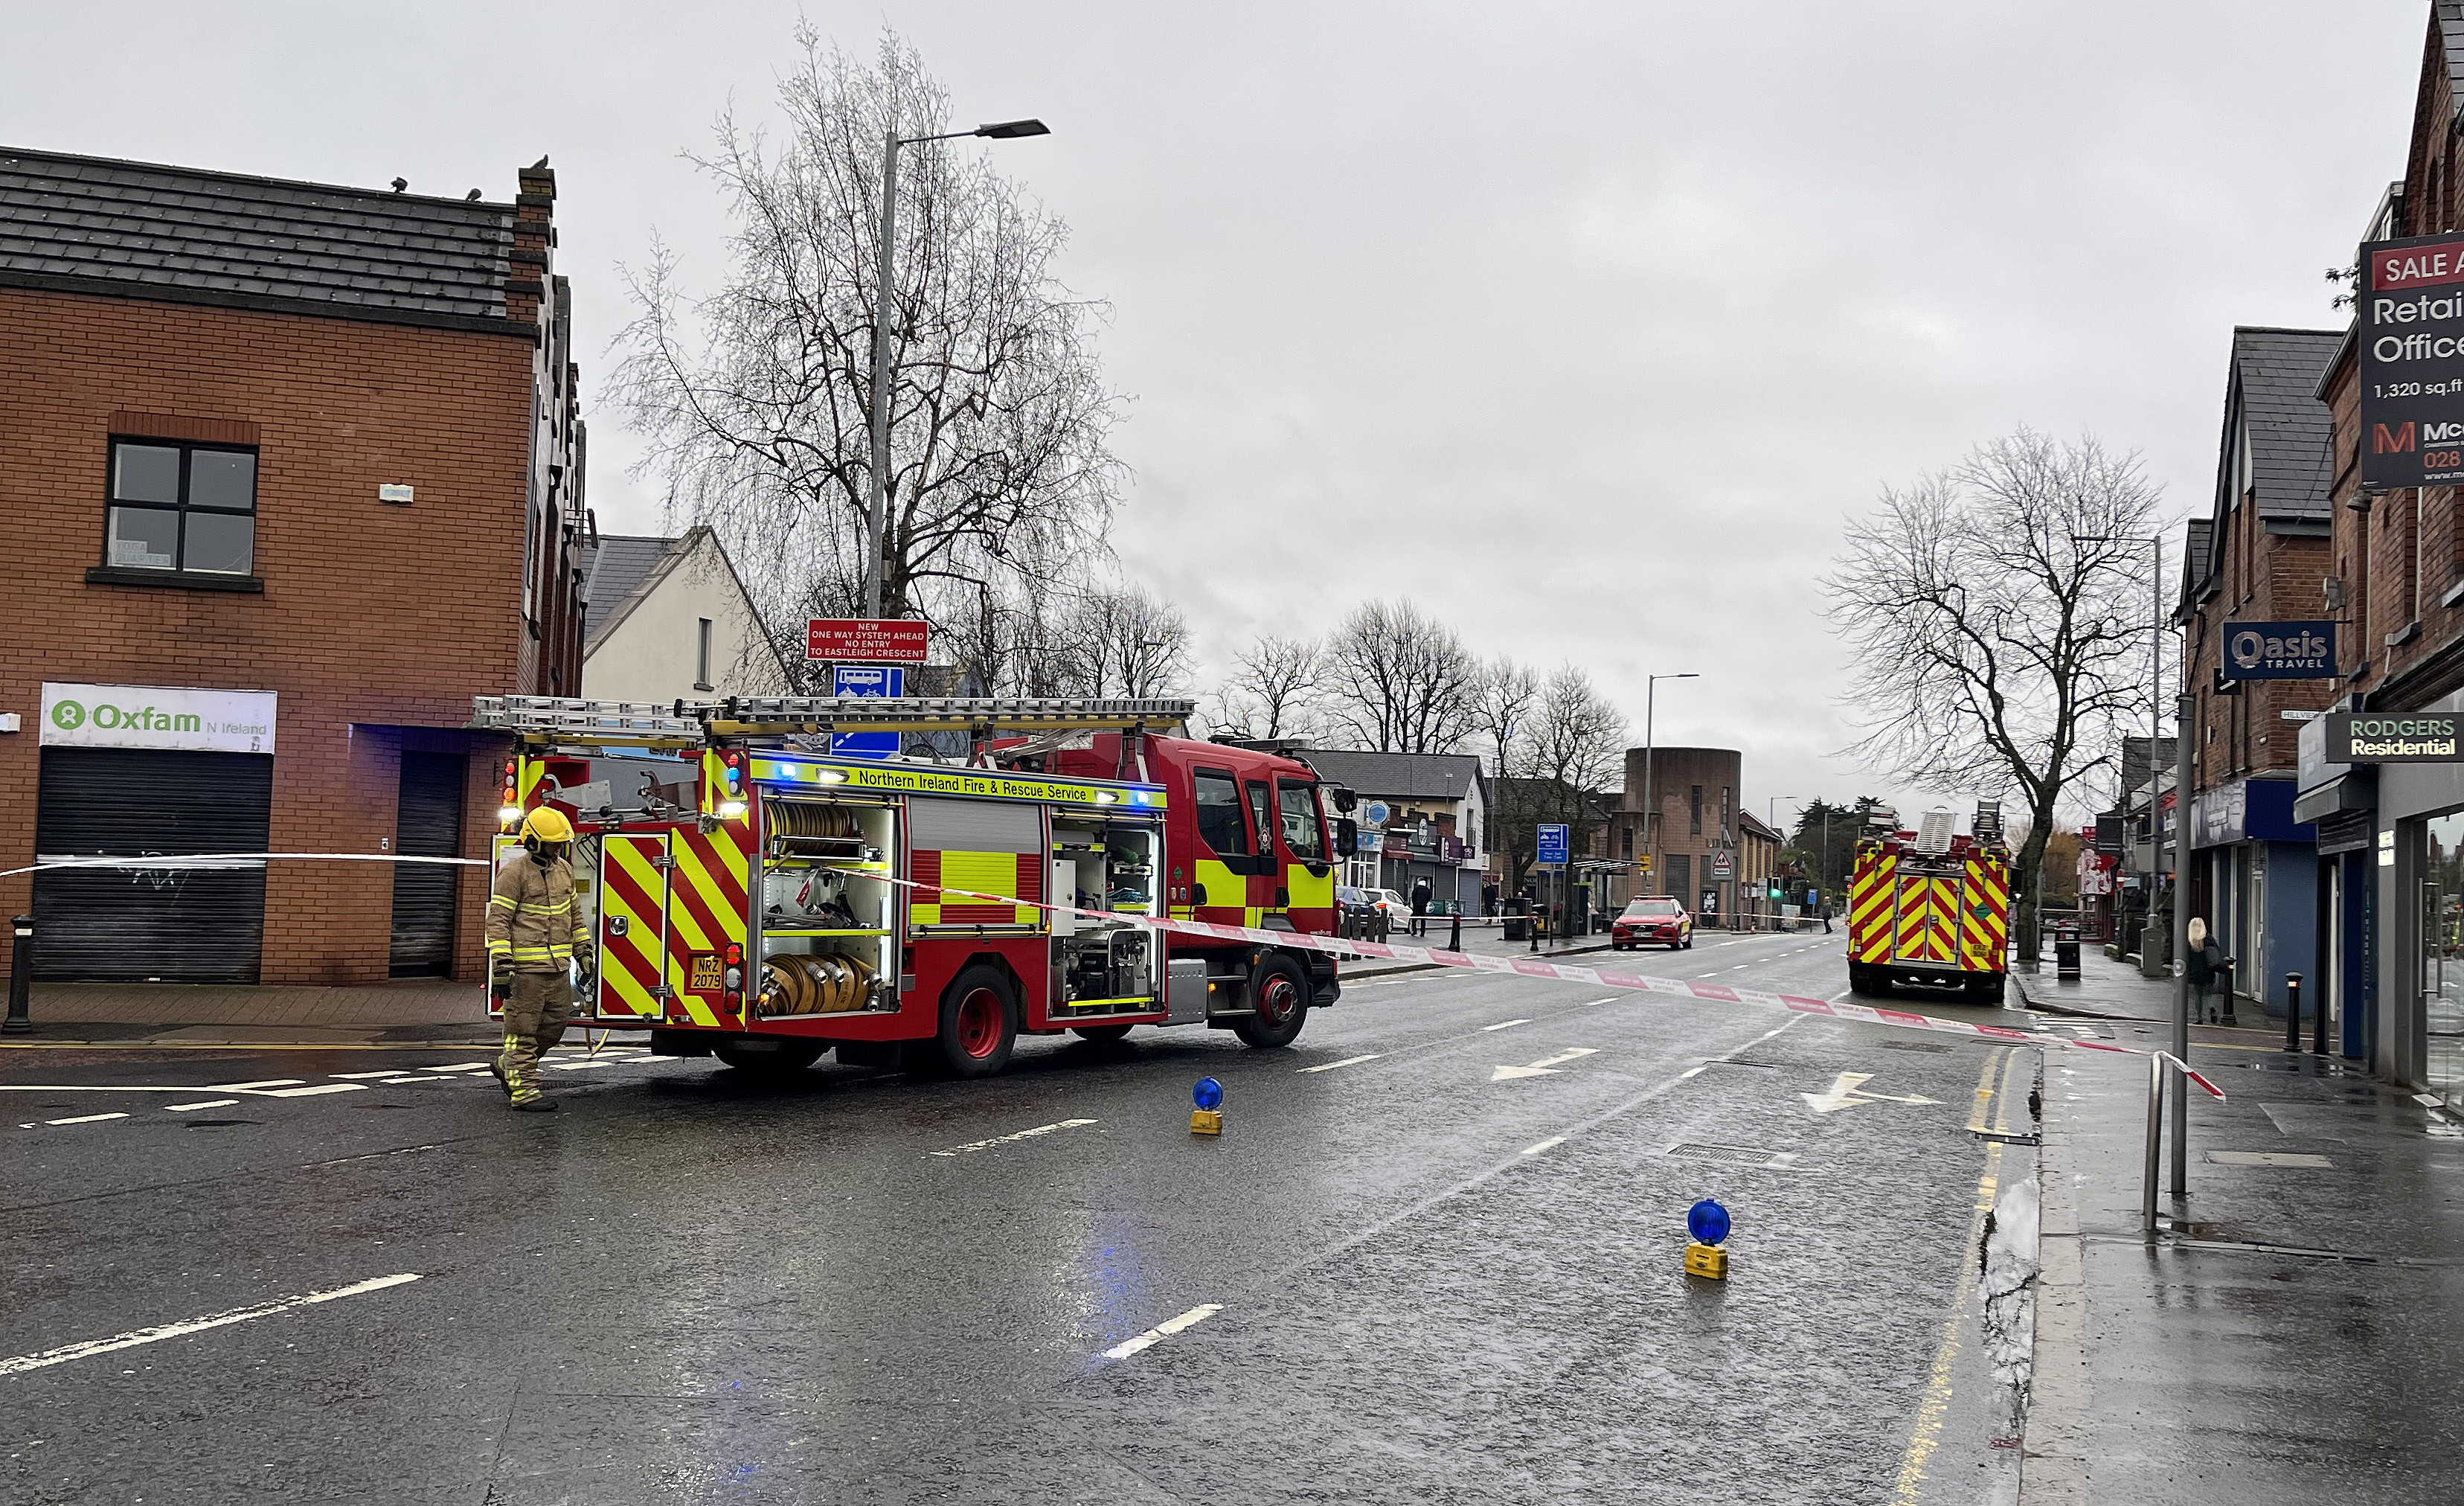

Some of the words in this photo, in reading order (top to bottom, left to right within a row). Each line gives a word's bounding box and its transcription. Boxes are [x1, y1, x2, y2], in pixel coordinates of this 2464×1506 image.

[2386, 253, 2448, 281] SALE
[2374, 382, 2422, 400] 1,320
[2425, 378, 2463, 397] sq.ft
[2372, 420, 2416, 454] M
[2424, 422, 2464, 441] Mc
[2424, 450, 2461, 468] 028
[858, 623, 879, 631] NEW
[856, 632, 891, 640] SYSTEM
[893, 632, 924, 641] AHEAD
[811, 647, 822, 656] TO
[825, 648, 873, 656] EASTLEIGH
[876, 650, 925, 658] CRESCENT
[2231, 630, 2328, 668] Oasis
[2265, 659, 2324, 668] TRAVEL
[93, 704, 202, 733] Oxfam
[207, 722, 216, 734] N
[222, 722, 268, 736] Ireland
[2350, 719, 2455, 737] RODGERS
[2351, 738, 2456, 755] Residential
[859, 770, 914, 788] Northern
[919, 775, 960, 791] Ireland
[964, 778, 986, 792] Fire
[990, 780, 998, 794] &
[1004, 781, 1044, 797] Rescue
[1047, 785, 1086, 801] Service
[698, 959, 719, 973] NRZ
[693, 974, 721, 987] 2079
